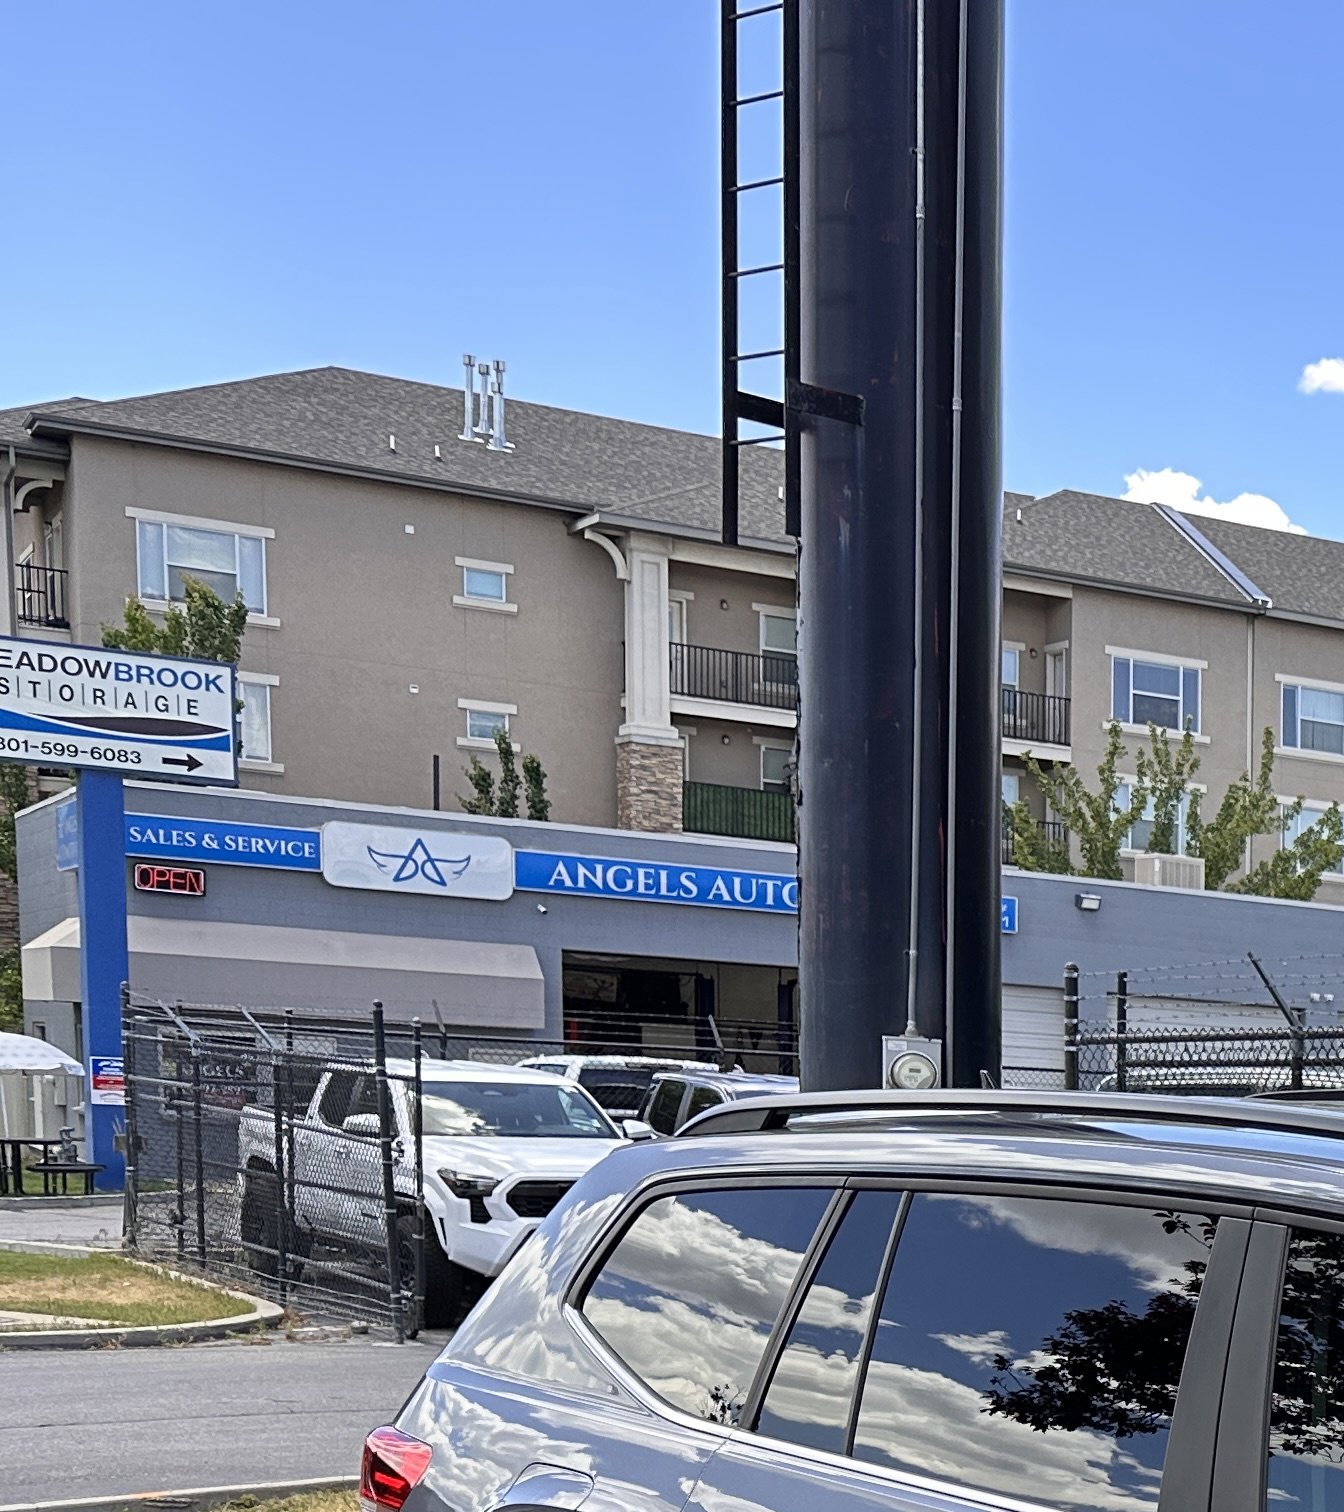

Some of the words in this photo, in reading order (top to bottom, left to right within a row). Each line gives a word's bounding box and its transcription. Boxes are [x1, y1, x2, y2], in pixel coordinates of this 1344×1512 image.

[0, 648, 225, 694] EADOWBROOK
[129, 826, 196, 847] SALES
[201, 832, 220, 850] &
[224, 835, 316, 858] SERVICE
[137, 866, 204, 895] OPEN
[548, 860, 698, 898] ANGELS
